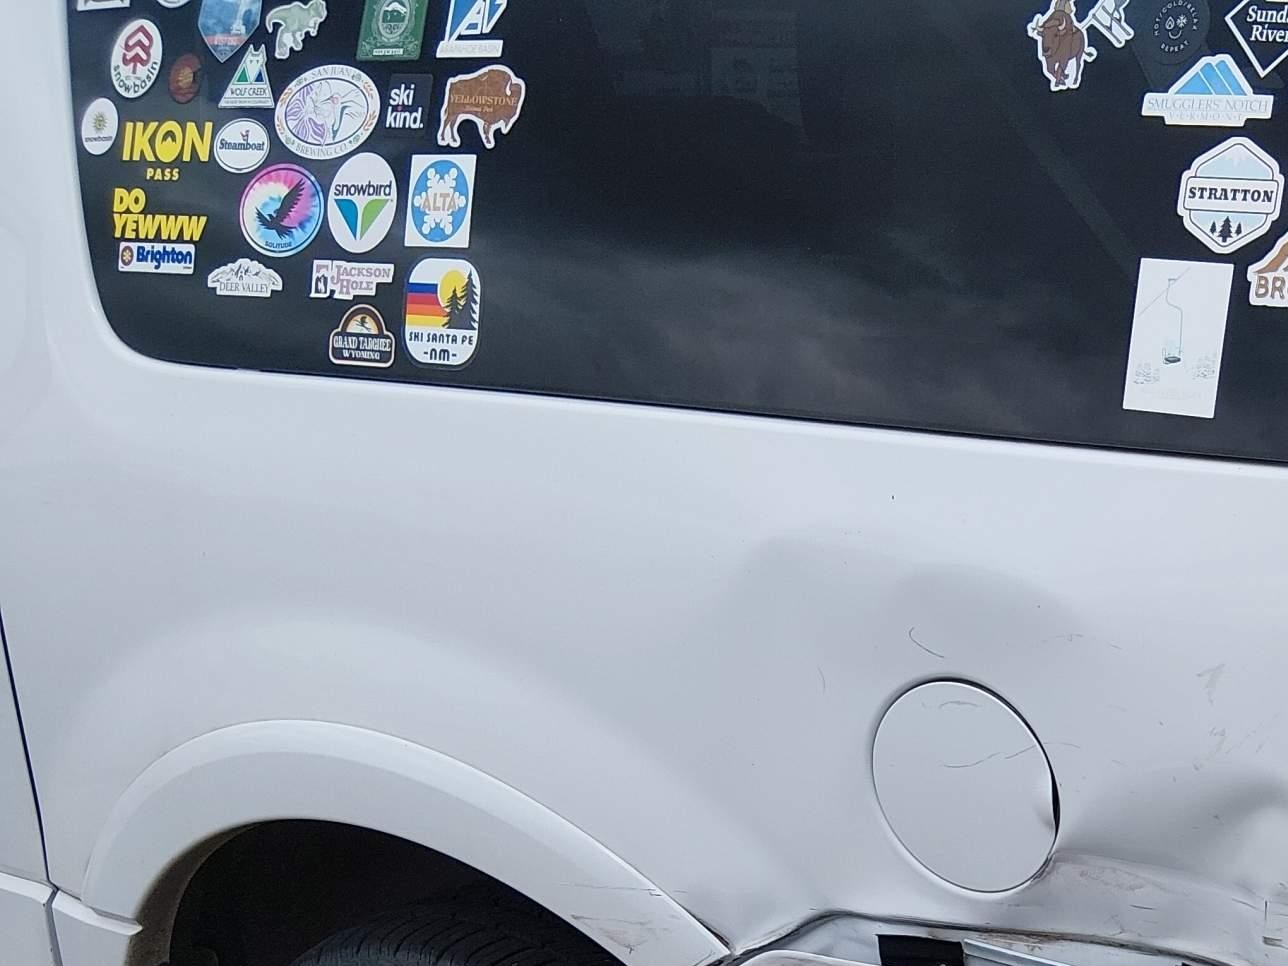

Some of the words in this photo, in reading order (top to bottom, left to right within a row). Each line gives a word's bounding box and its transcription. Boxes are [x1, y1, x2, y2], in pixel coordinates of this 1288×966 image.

[114, 60, 159, 94] snowbasin
[311, 67, 329, 80] SAN
[330, 66, 351, 77] JUAN
[230, 87, 247, 96] WOLF
[248, 87, 267, 97] CREEK
[389, 84, 416, 106] ski
[450, 93, 518, 106] YELLOWSTONE
[1224, 99, 1268, 113] NOTCH
[386, 107, 424, 129] kind.
[122, 120, 213, 163] IKON
[219, 137, 265, 151] Steamboat
[295, 143, 332, 157] BREWING
[145, 168, 180, 181] PASS
[334, 180, 393, 197] snowbird
[1188, 186, 1275, 203] STRATTON
[112, 187, 146, 213] DO
[422, 192, 457, 212] ALTA
[112, 213, 208, 241] YEWWW
[265, 240, 293, 249] SOLITUDE
[136, 245, 192, 269] Brighton
[219, 281, 240, 292] DEER
[242, 282, 270, 294] VALLEY
[338, 278, 374, 296] HOLE
[334, 335, 358, 349] GRAND
[359, 337, 391, 352] TARGHEE
[408, 331, 424, 343] SKI
[426, 332, 458, 345] SANTA
[342, 351, 381, 361] WYOMING
